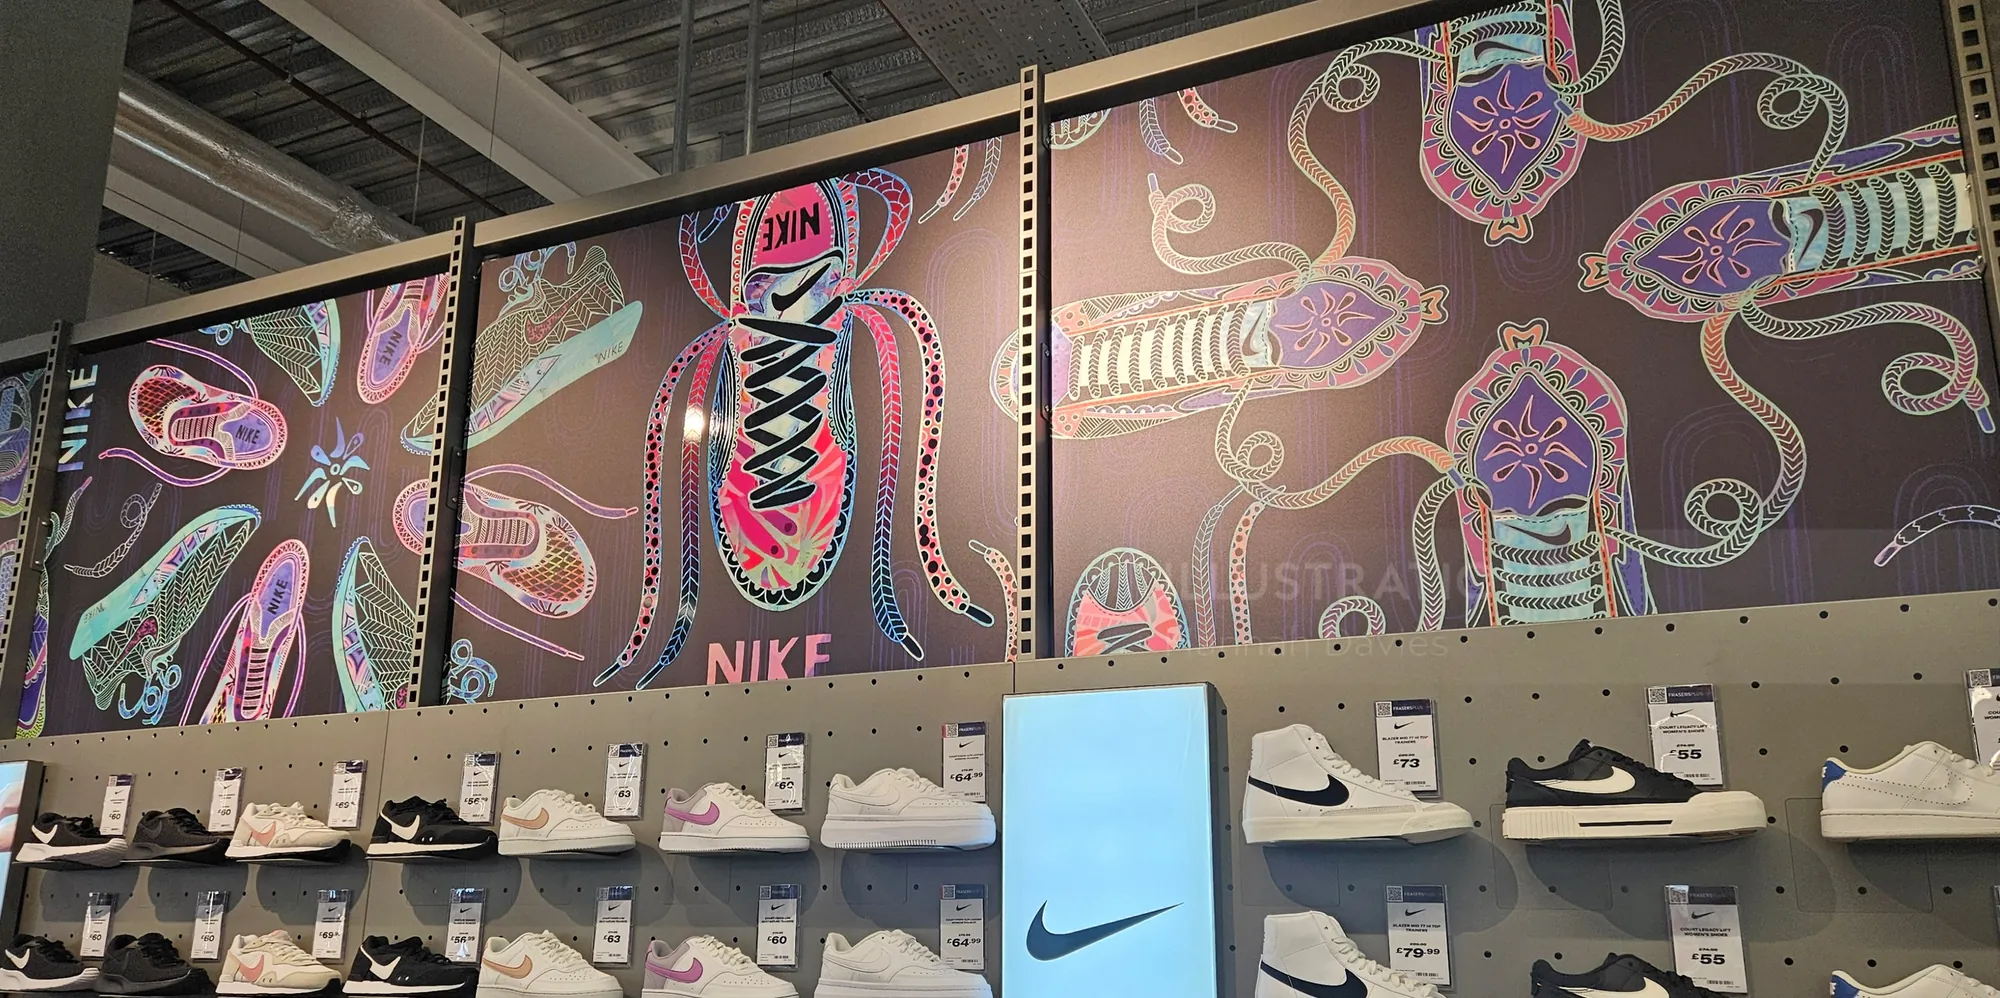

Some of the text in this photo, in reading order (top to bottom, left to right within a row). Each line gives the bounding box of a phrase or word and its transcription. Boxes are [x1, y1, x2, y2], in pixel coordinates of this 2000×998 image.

[762, 202, 820, 251] NIKE
[379, 331, 403, 366] NIKE
[595, 341, 623, 363] NIKE
[57, 365, 98, 472] NIKE
[236, 424, 260, 444] NIKE
[267, 579, 288, 615] NIKE
[707, 634, 832, 685] NIKE
[1670, 749, 1702, 760] £55
[1393, 759, 1420, 768] £73
[950, 772, 984, 783] £64.99
[774, 781, 794, 790] £60
[603, 935, 621, 943] £63
[767, 936, 787, 945] £60
[947, 938, 981, 948] £64.99
[1396, 947, 1440, 958] £79.99
[1692, 953, 1725, 965] £55
